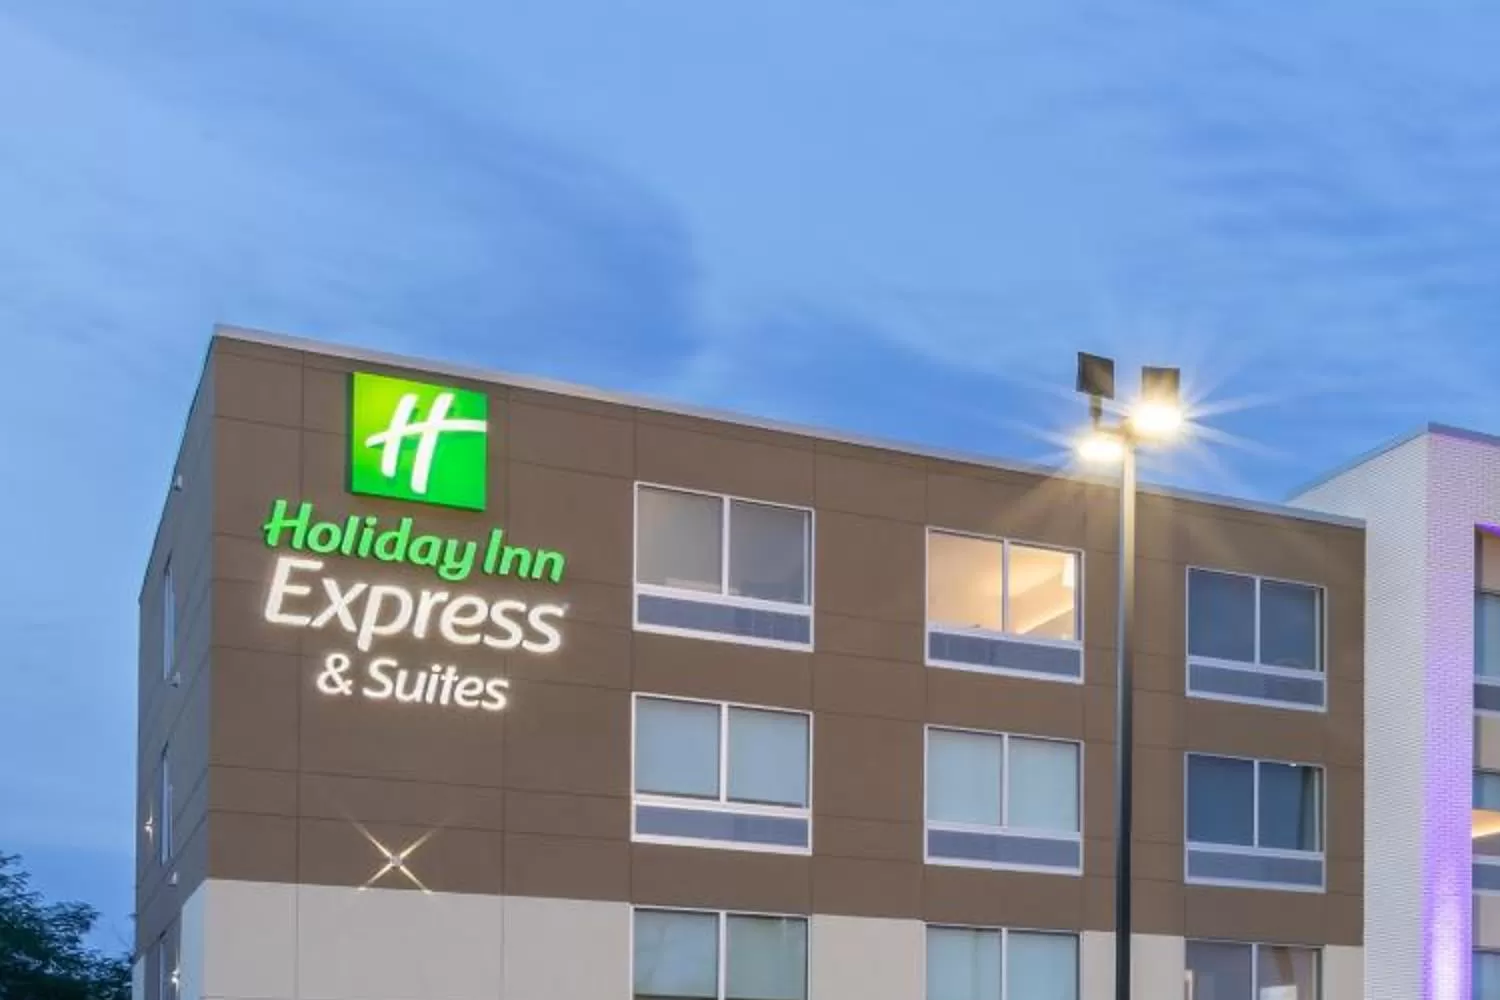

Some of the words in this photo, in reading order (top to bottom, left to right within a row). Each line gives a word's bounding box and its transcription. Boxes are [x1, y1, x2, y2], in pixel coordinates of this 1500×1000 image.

[263, 499, 478, 581] Holiday
[482, 527, 566, 583] Inn
[263, 556, 565, 653] Express
[316, 652, 353, 696] &
[362, 657, 510, 711] Suites
